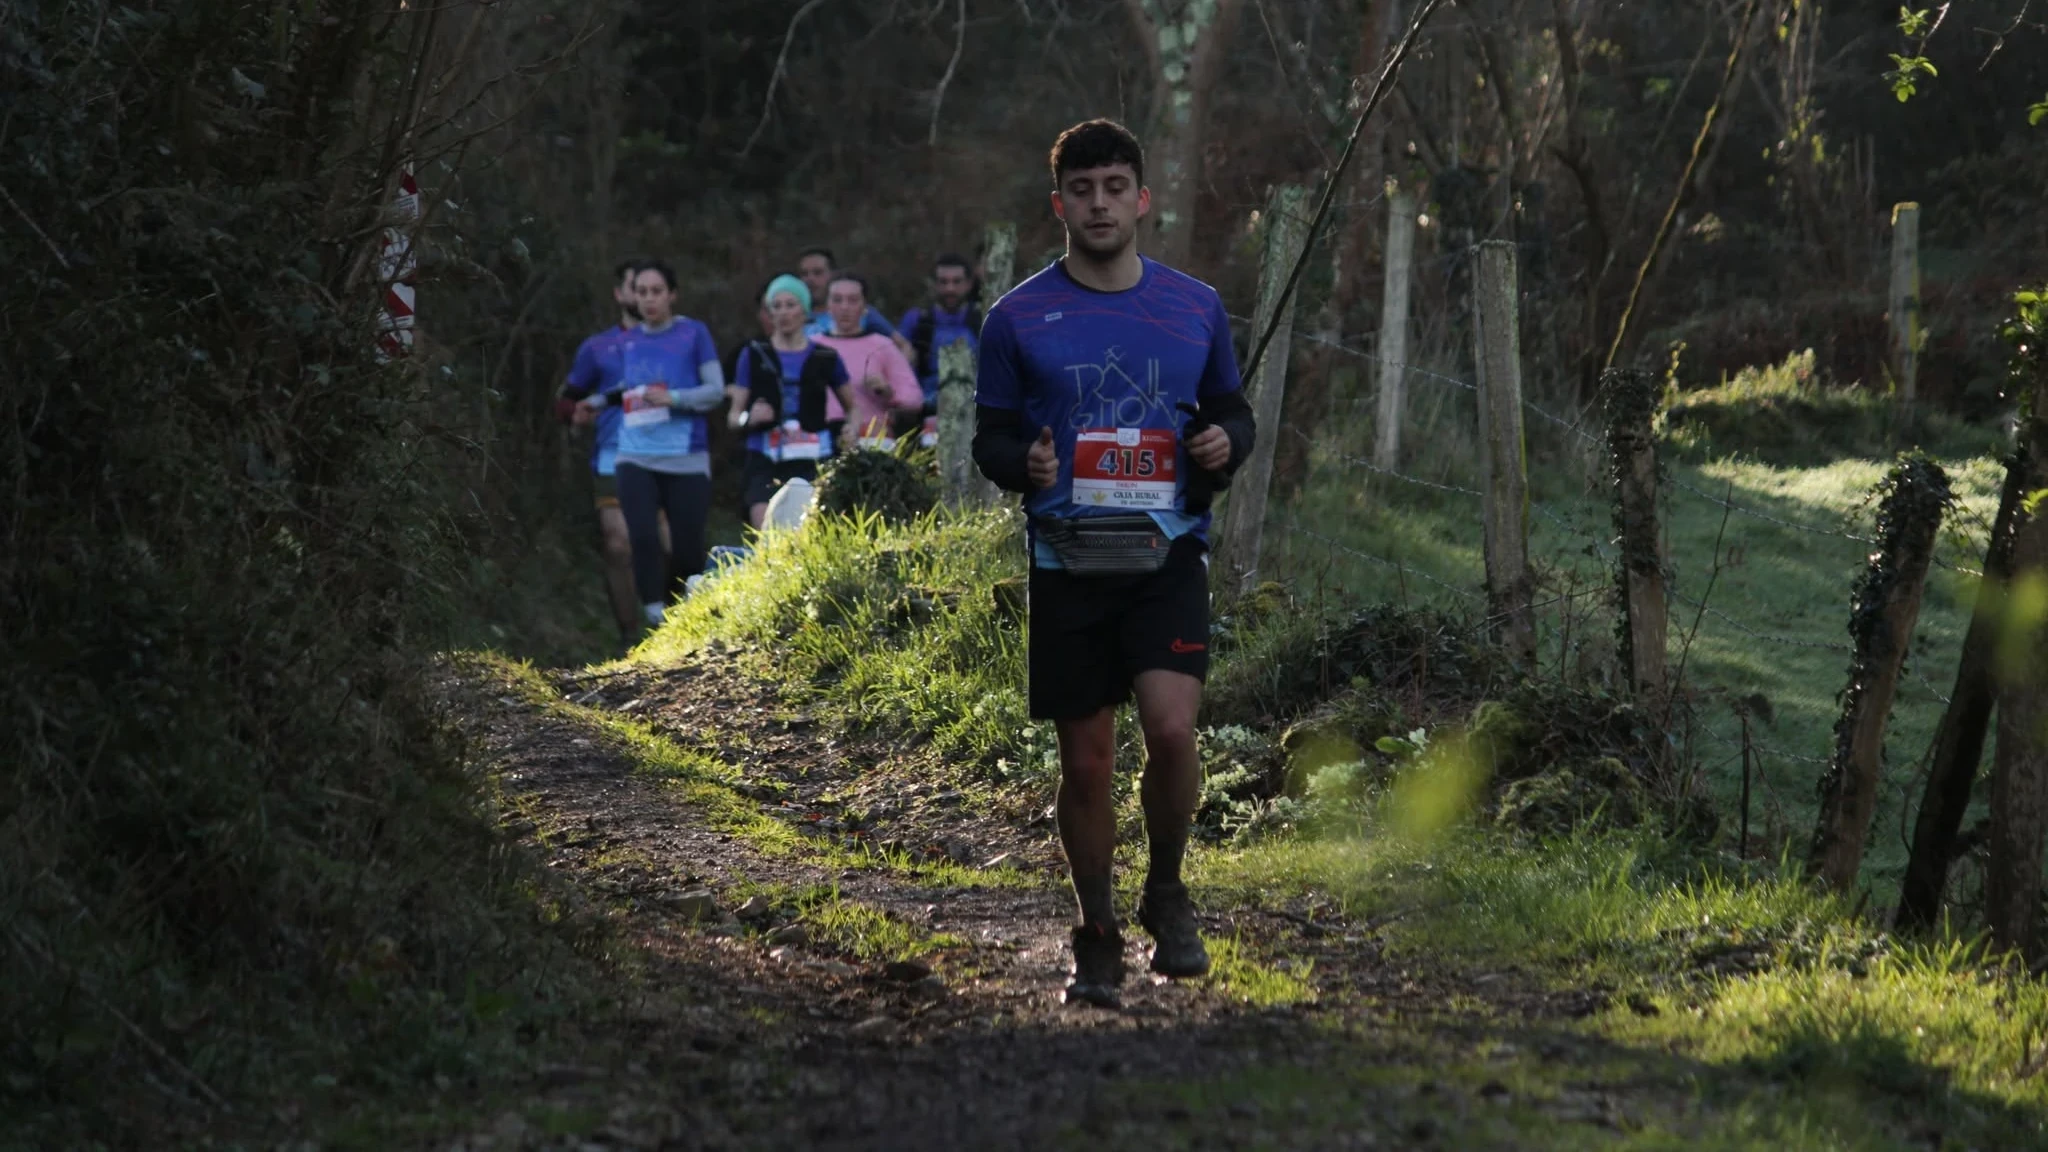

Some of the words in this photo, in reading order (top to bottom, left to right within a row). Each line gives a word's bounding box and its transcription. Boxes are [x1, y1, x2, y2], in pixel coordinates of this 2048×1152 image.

[1096, 448, 1156, 477] 415
[1113, 491, 1134, 500] CAJA
[1135, 491, 1162, 500] RURAL
